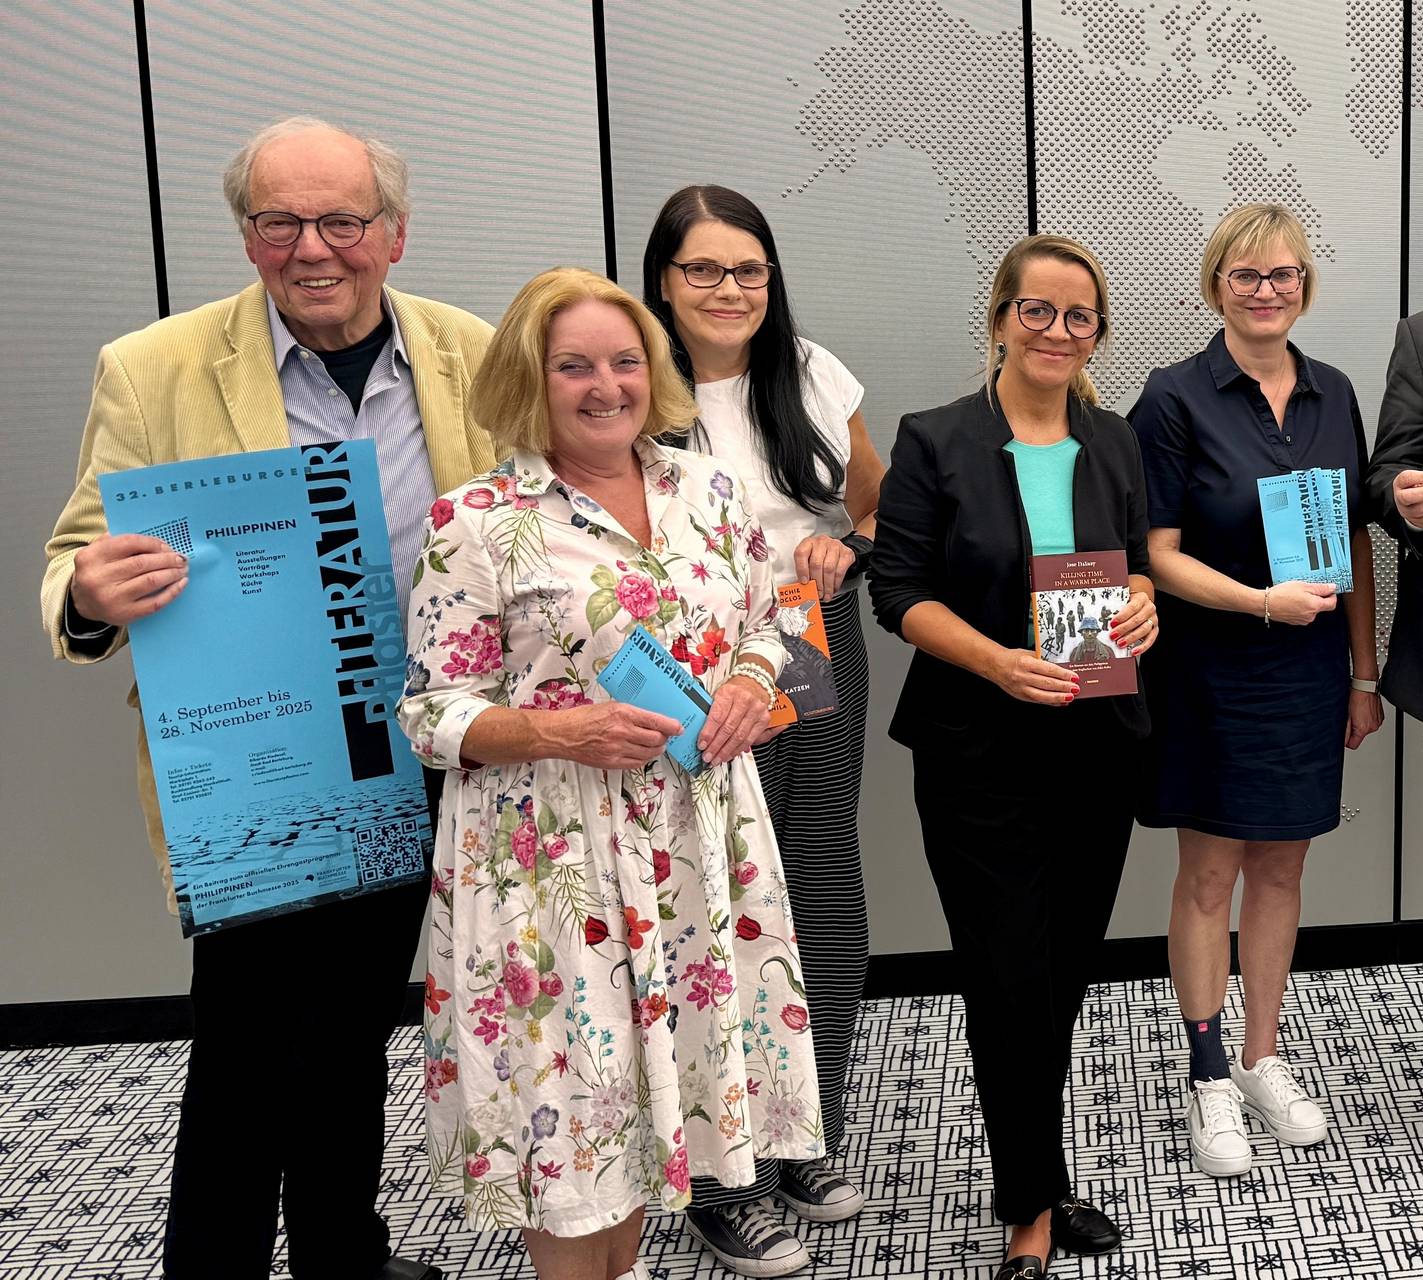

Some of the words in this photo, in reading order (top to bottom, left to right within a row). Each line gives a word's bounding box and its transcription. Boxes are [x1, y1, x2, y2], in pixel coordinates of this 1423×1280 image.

[116, 491, 147, 502] 32.
[155, 466, 313, 495] BERLEBURGER
[205, 518, 297, 540] PHILIPPINEN
[235, 548, 266, 558] Literatur
[237, 553, 286, 565] Ausstellungen
[239, 569, 280, 581] Workshops
[1090, 577, 1110, 585] PLACE
[242, 587, 263, 596] Kunst
[778, 588, 801, 597] RCHIE
[784, 684, 810, 695] KATZEN
[157, 711, 173, 724] 4.
[177, 694, 264, 721] September
[268, 689, 291, 703] bis
[160, 725, 186, 739] 28.
[190, 707, 272, 734] November
[276, 699, 314, 719] 2025
[195, 881, 254, 900] PHILIPPINEN
